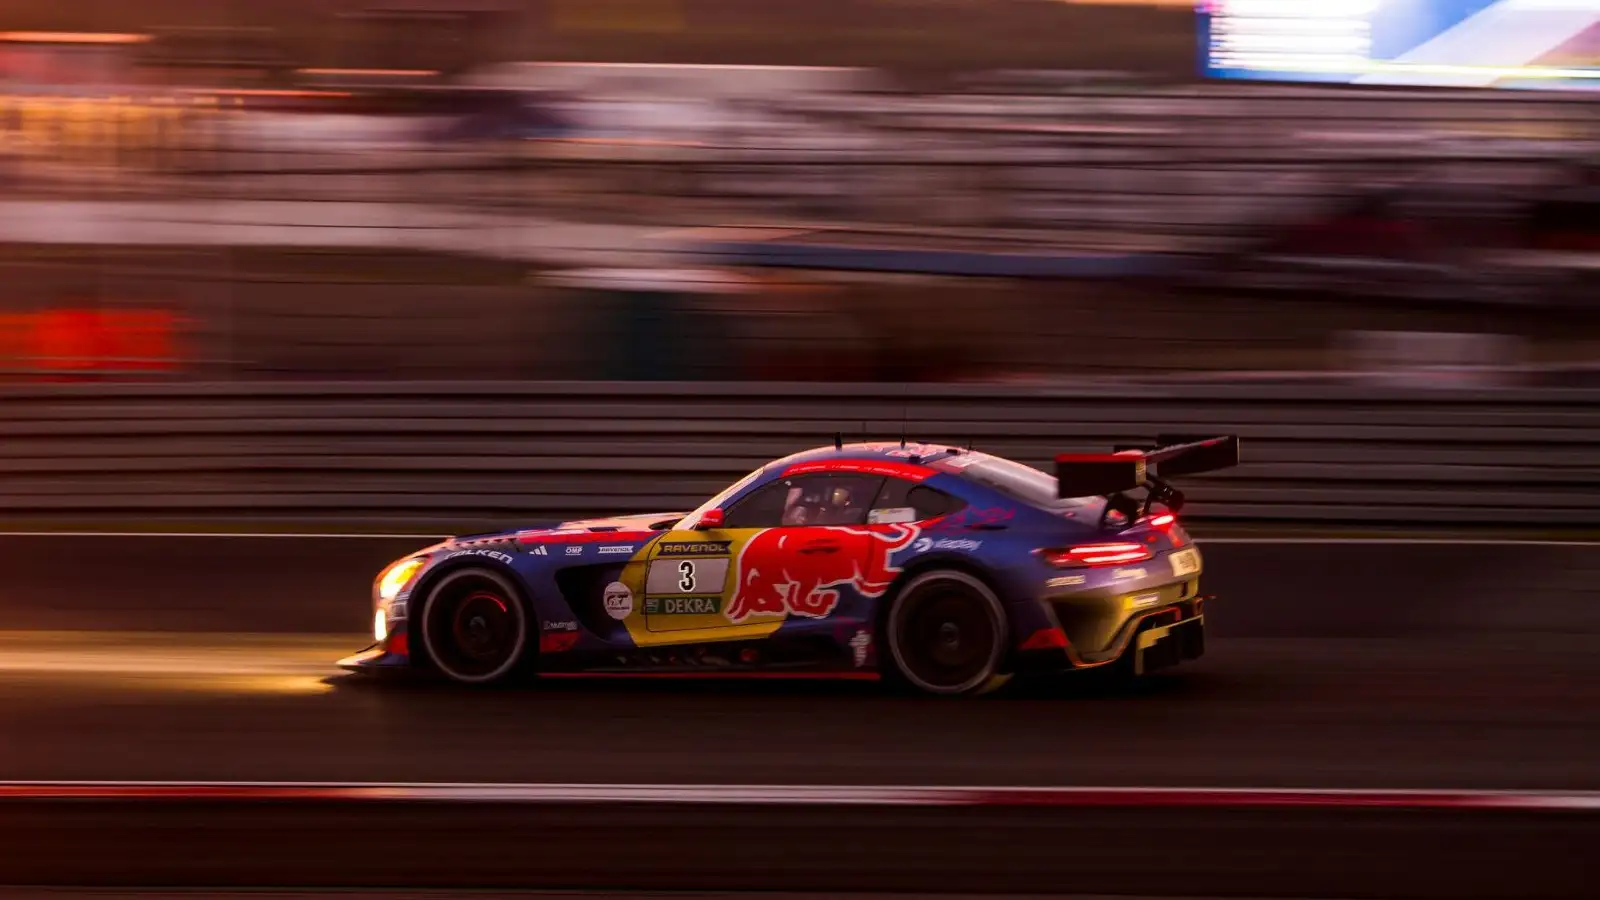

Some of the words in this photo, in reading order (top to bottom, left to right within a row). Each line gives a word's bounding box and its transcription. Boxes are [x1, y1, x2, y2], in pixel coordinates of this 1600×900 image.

[565, 546, 583, 554] OMP
[663, 543, 726, 553] RAVENOL
[444, 549, 514, 565] FALKEN
[678, 560, 696, 593] 3
[664, 598, 716, 614] DEKRA
